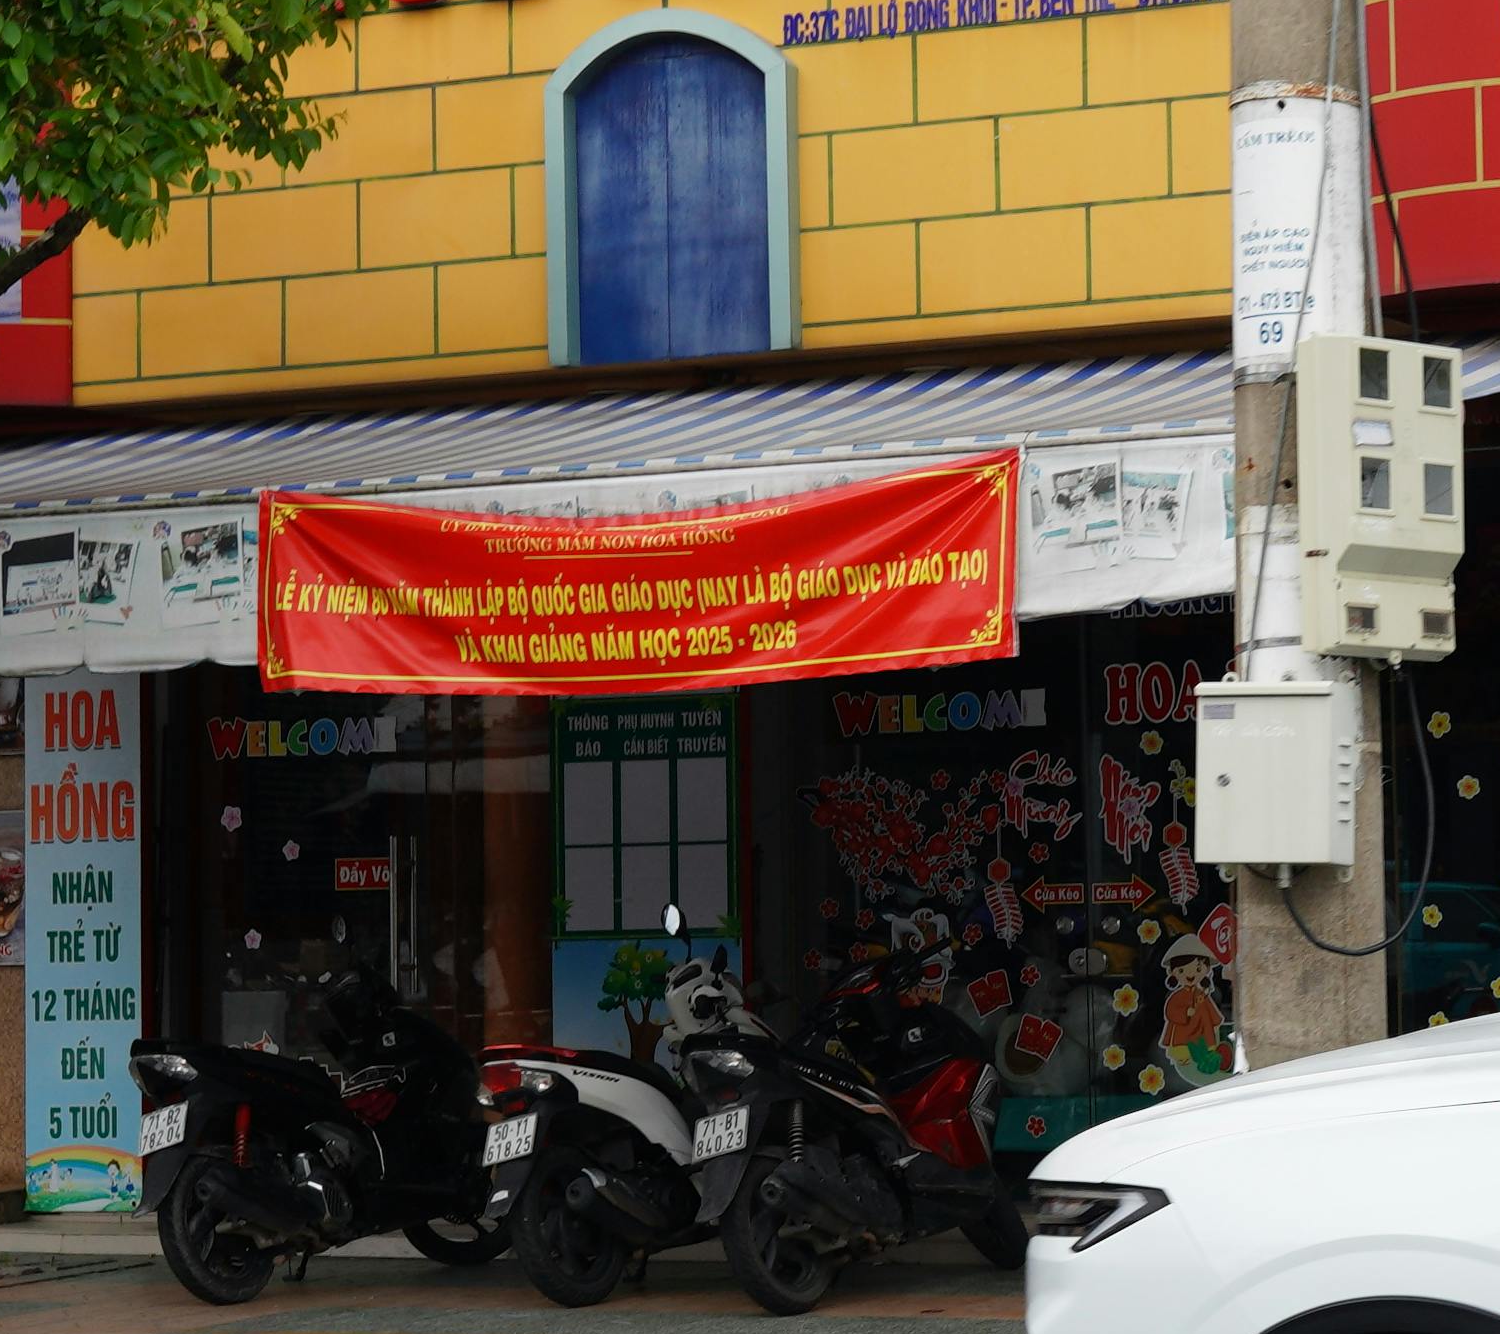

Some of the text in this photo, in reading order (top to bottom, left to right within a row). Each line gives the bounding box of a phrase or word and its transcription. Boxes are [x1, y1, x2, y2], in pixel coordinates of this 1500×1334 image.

[845, 7, 871, 42] ĐẠI
[879, 3, 897, 39] LỘ
[1259, 320, 1283, 345] 69
[600, 535, 638, 550] NON
[327, 578, 367, 622] NIỆM
[423, 579, 474, 616] THÀNH
[477, 578, 504, 624] LẬP
[507, 578, 528, 624] BỘ
[531, 572, 575, 616] QUỐC
[579, 583, 606, 613] GIA
[611, 573, 652, 613] GIÁO
[657, 578, 693, 616] DỤC
[697, 577, 737, 615] (NAY
[743, 565, 765, 605] LÀ
[769, 562, 792, 610] BỘ
[797, 559, 839, 601] GIÁO
[846, 564, 881, 603] DỤC
[948, 547, 988, 589] TẠO)
[481, 633, 525, 663] KHAI
[529, 623, 587, 663] GIẢNG
[591, 624, 634, 661] NĂM
[640, 628, 681, 666] HỌC
[688, 624, 733, 656] 2025
[750, 619, 797, 652] 2026
[45, 689, 121, 752] HOA
[834, 687, 1047, 737] WELCOME
[207, 716, 397, 760] WELCOME
[30, 762, 135, 844] HỒNG
[52, 863, 113, 911] NHẬN
[47, 919, 122, 964] TRẺ TỪ
[32, 981, 136, 1022] 12 THÁNG
[61, 1036, 105, 1080] ĐẾN
[50, 1092, 118, 1139] 5 TUỔI
